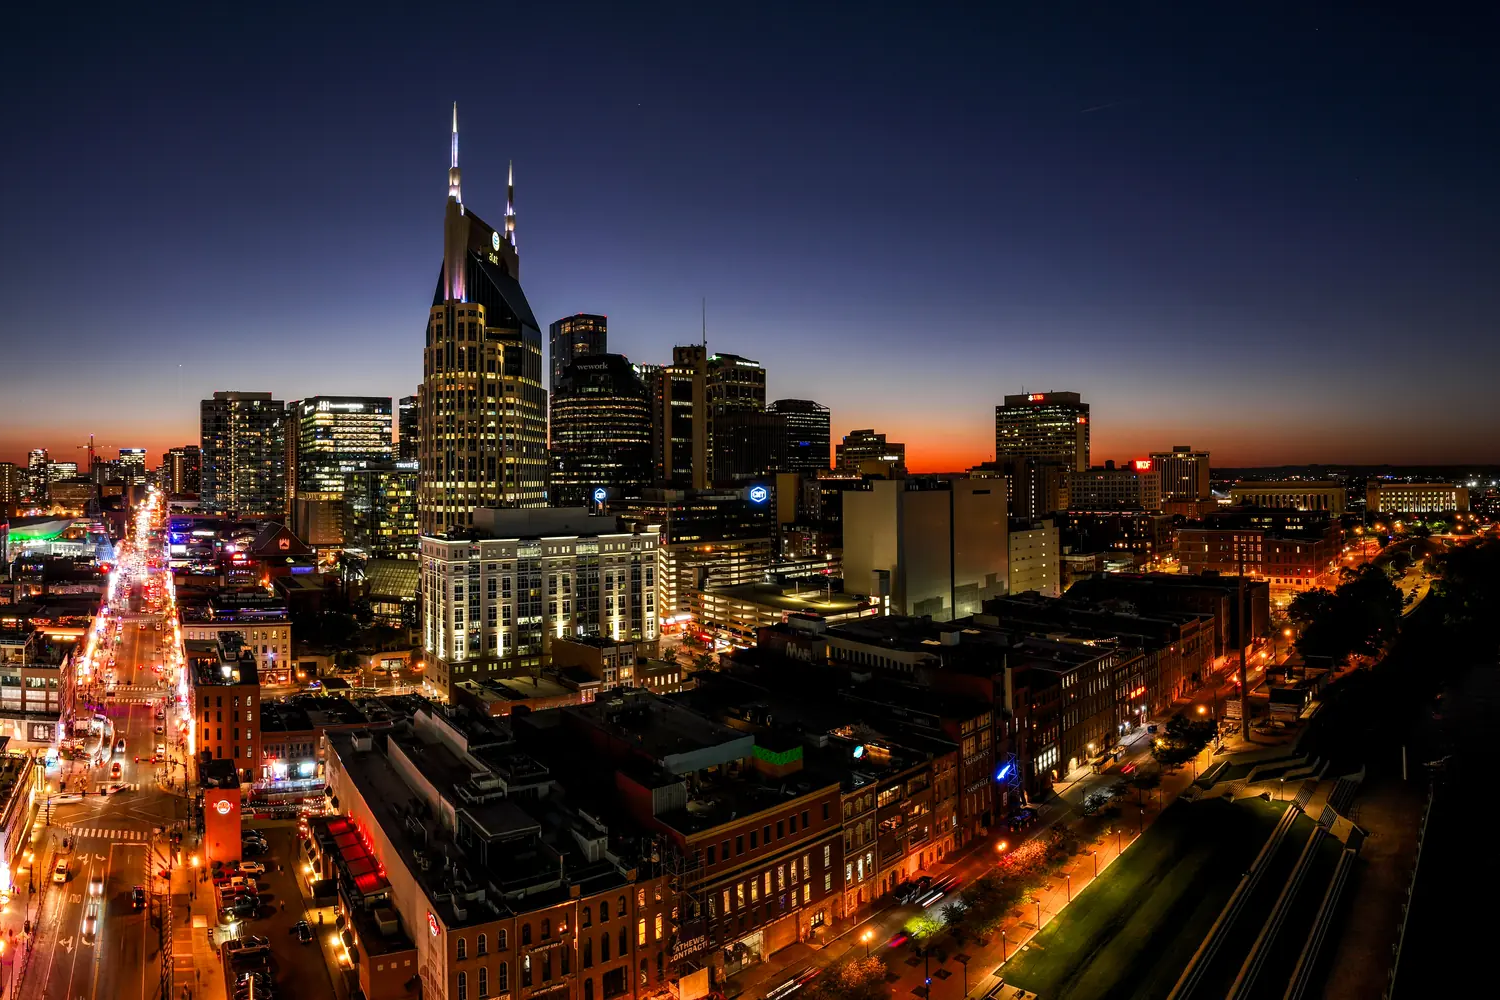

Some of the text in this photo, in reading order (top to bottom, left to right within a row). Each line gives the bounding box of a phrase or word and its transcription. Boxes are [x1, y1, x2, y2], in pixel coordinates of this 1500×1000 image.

[577, 362, 608, 371] wework
[1135, 460, 1152, 470] WKDF
[673, 935, 705, 953] ATHEWS
